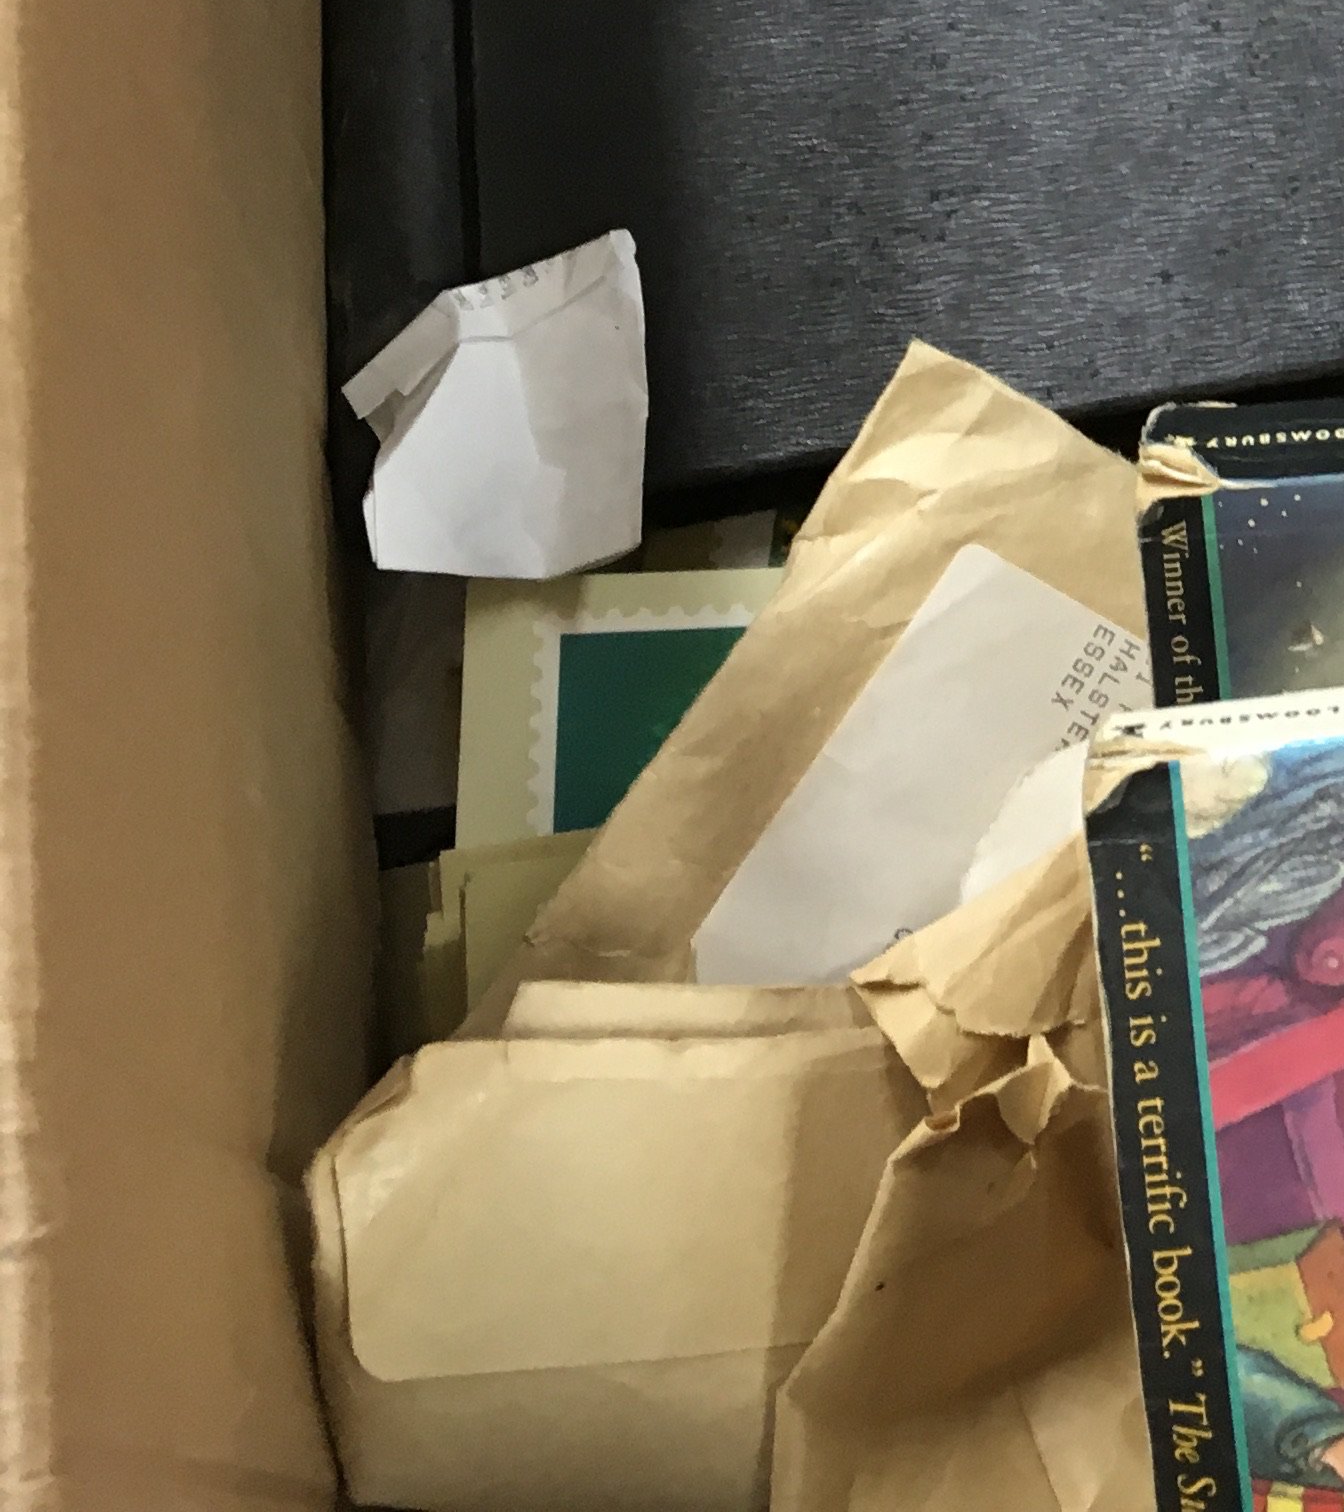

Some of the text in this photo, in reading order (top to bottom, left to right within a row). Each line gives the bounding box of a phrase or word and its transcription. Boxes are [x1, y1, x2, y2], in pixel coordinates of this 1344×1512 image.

[1161, 520, 1190, 626] Winner
[1051, 623, 1116, 712] ESSEX
[1171, 634, 1202, 667] of
[1129, 1014, 1168, 1047] is
[1133, 1060, 1159, 1084] a
[1129, 1100, 1184, 1236] terrific
[1169, 1392, 1213, 1463] The
